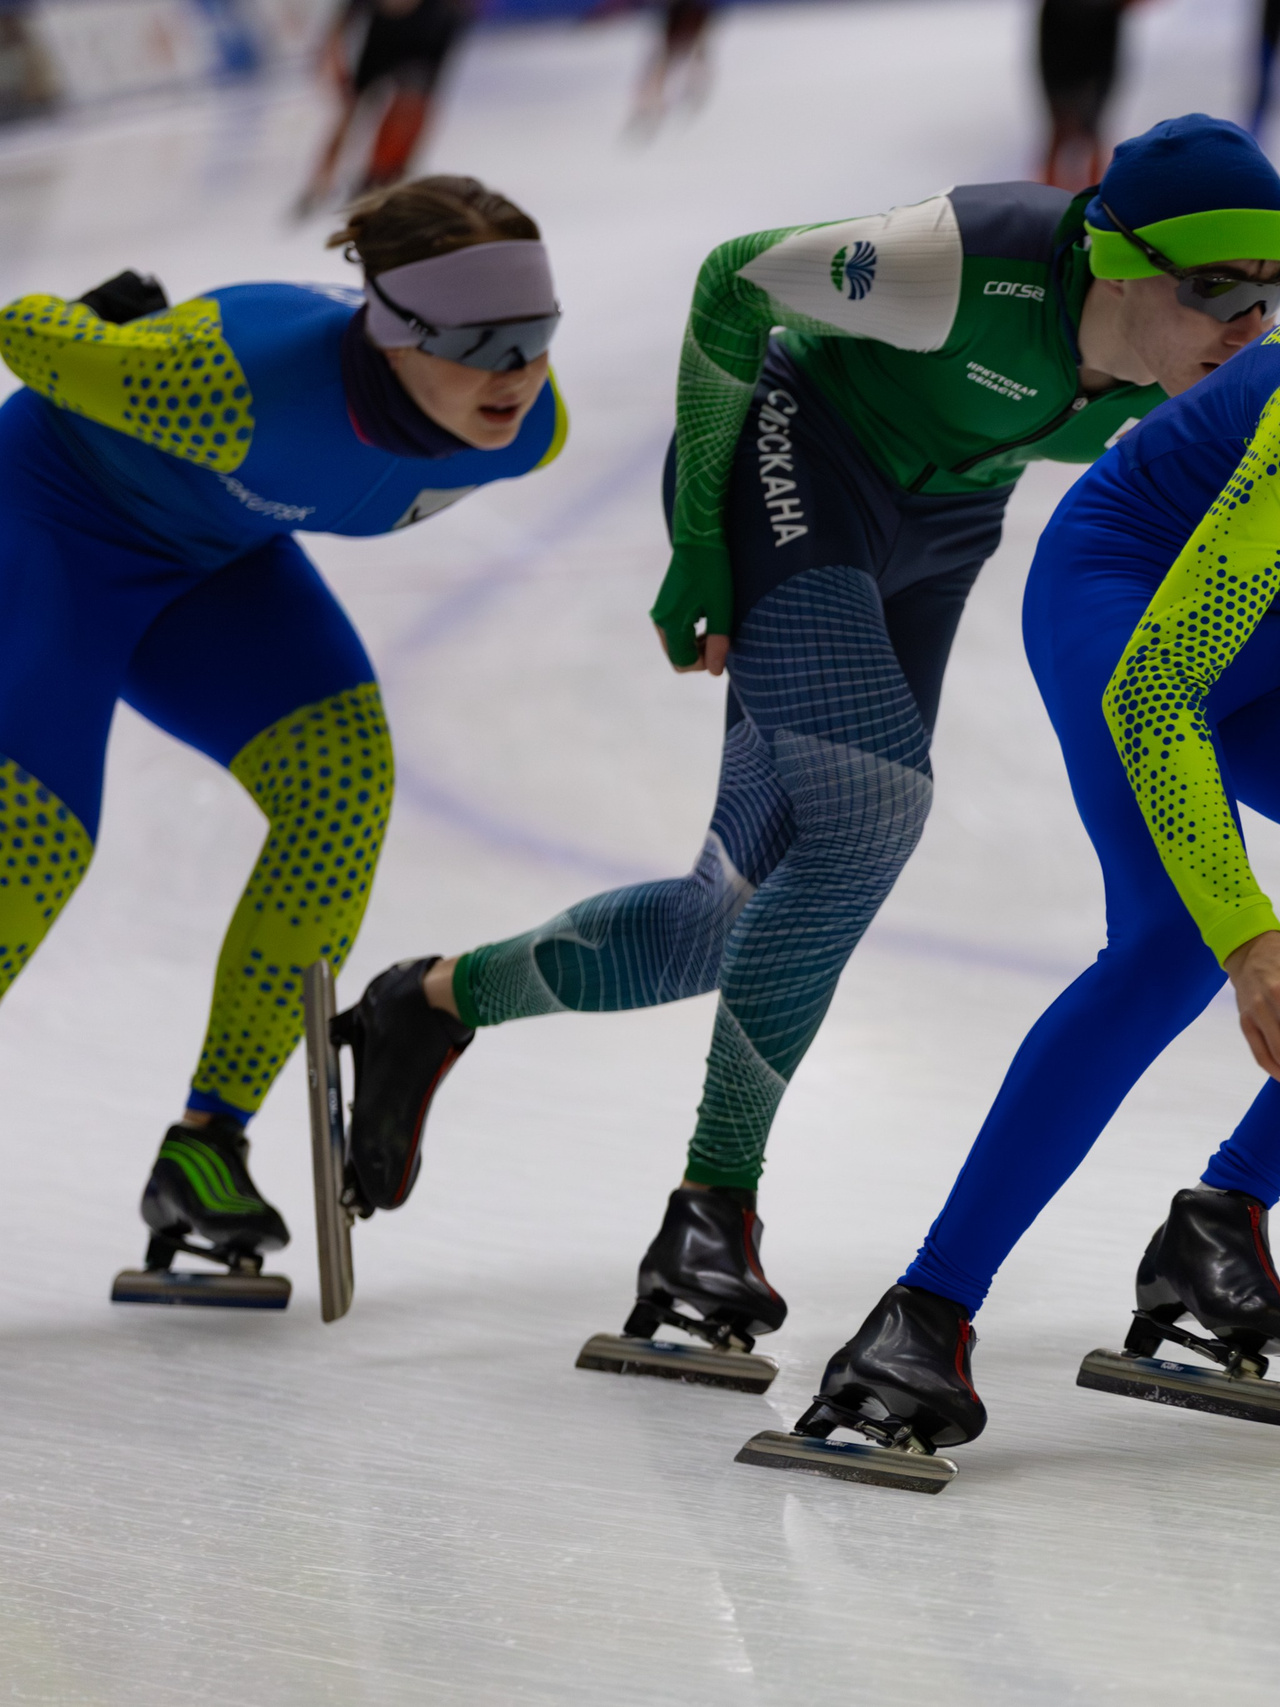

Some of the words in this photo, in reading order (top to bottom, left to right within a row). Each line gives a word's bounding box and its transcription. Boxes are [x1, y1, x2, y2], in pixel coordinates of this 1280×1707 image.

[983, 281, 1045, 302] corsa
[966, 361, 1038, 397] ИРКУТСКАЯ
[967, 372, 1022, 401] ОБЛАСТЬ
